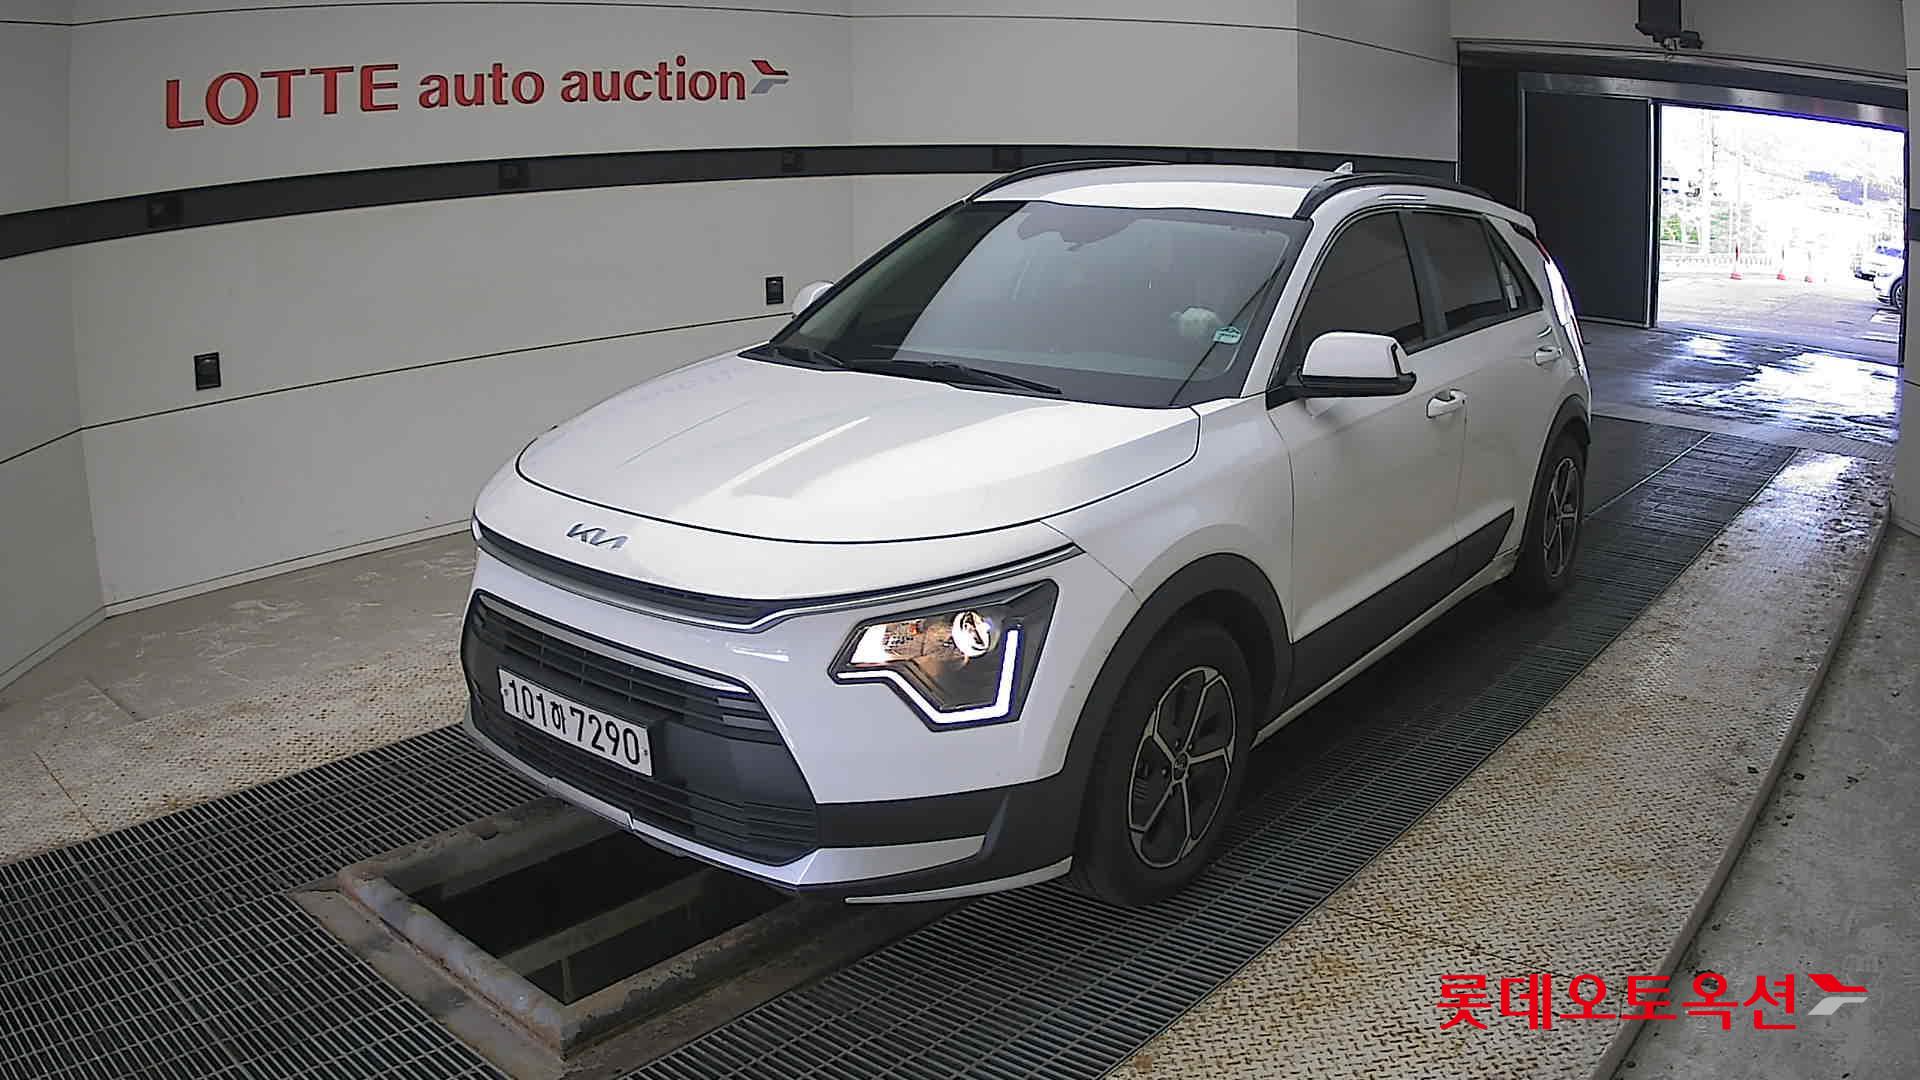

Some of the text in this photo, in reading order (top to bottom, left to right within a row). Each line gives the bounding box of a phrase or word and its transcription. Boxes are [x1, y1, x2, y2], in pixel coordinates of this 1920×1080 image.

[165, 56, 746, 129] LOTTE auto auction
[566, 523, 628, 550] KIA
